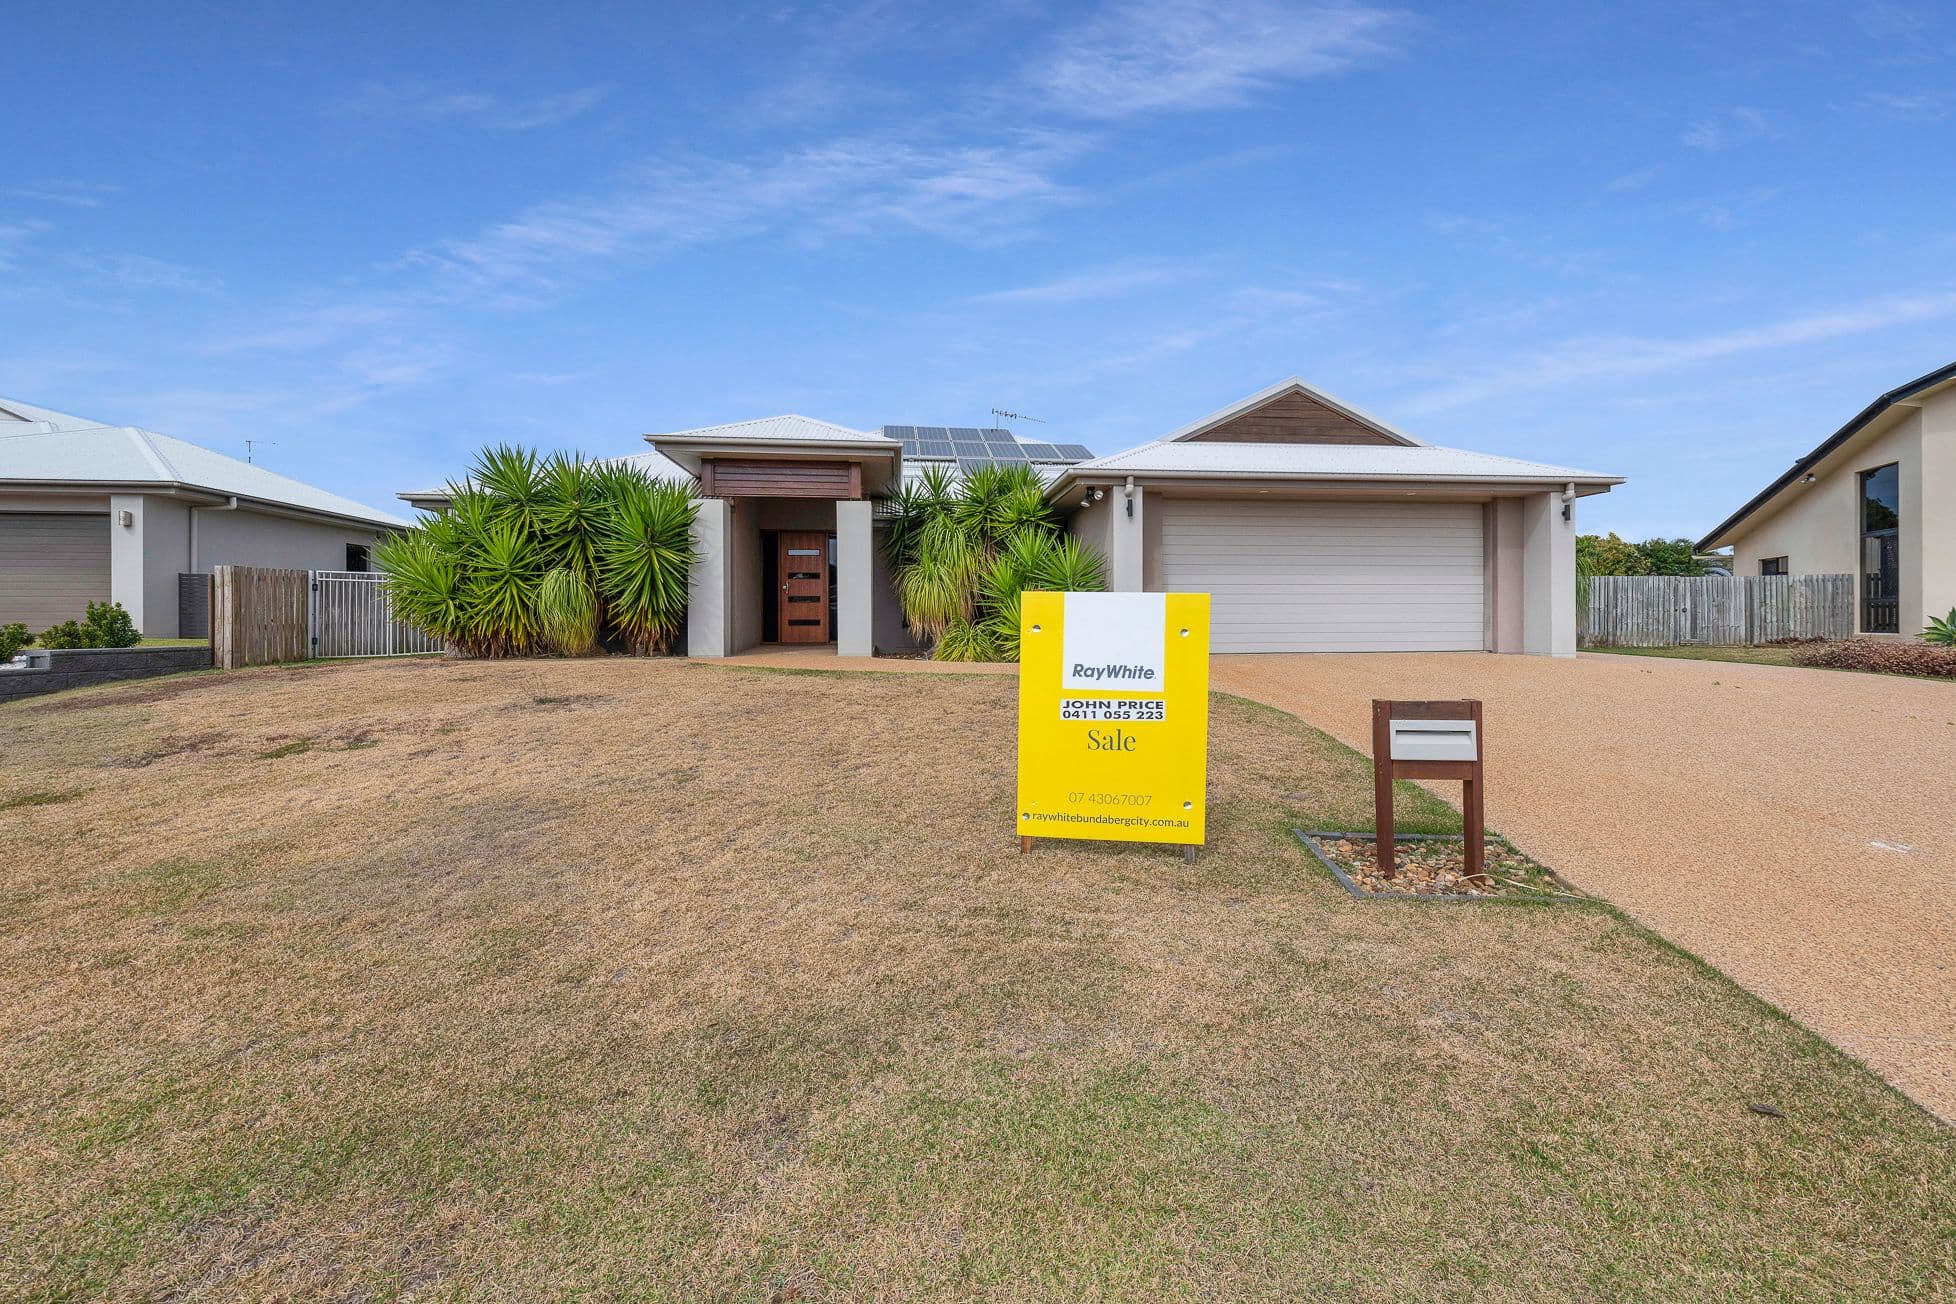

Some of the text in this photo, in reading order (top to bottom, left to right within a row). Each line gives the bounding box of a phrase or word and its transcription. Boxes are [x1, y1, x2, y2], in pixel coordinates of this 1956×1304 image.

[1063, 701, 1164, 710] JOHN PRICE
[1062, 710, 1164, 720] 0411 055 223
[1087, 729, 1136, 752] Sale
[1068, 792, 1152, 806] 07 43067007
[1032, 812, 1189, 828] raywhitebundabergcity.com.au
